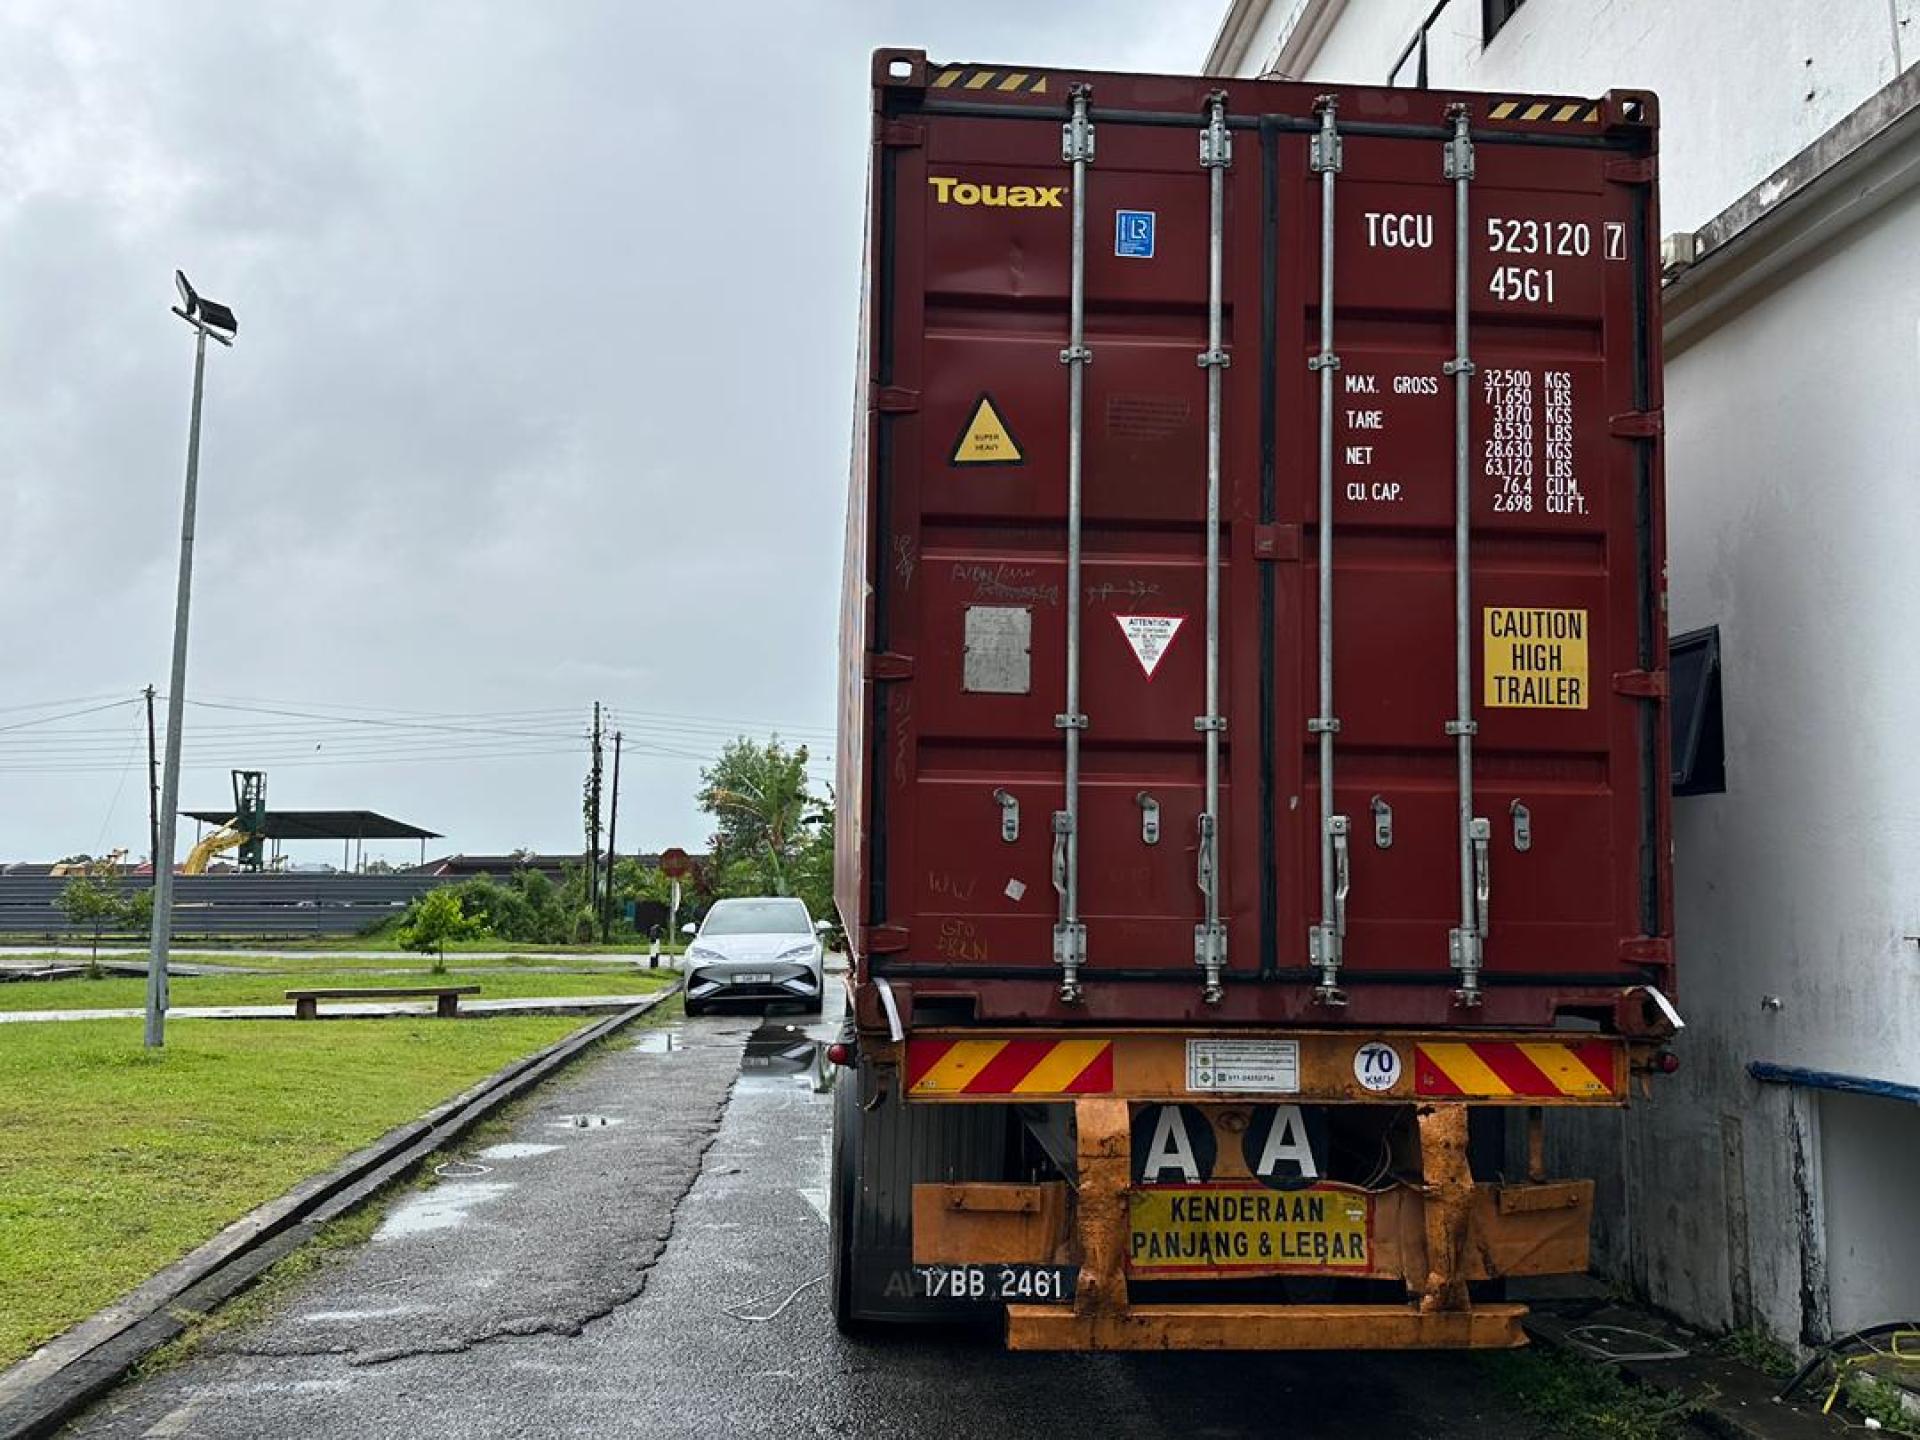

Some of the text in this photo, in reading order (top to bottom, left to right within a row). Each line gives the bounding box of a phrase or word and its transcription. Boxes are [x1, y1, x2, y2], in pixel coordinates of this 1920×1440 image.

[928, 177, 1064, 207] Touax
[1365, 213, 1623, 257] TGCU 523120 7
[1489, 267, 1555, 303] 45G1
[1346, 370, 1571, 395] MAX. GROSS 32.500 KGS
[1485, 388, 1572, 406] 71.650 LBS
[1346, 406, 1572, 429] TARE 3.870 KGS
[1494, 424, 1572, 441] 8.530 LBS
[1347, 441, 1573, 465] NET 28.630 KGS
[1485, 459, 1572, 477] 63.120 LBS
[1372, 483, 1404, 501] CAP.
[1502, 477, 1532, 494] 76.4
[1494, 495, 1533, 513] 2.698
[1129, 618, 1170, 626] ATTENTION
[1491, 610, 1582, 639] CAUTION
[1512, 643, 1562, 671] HIGH
[1494, 676, 1580, 705] TRAILER
[1360, 1049, 1393, 1073] 70
[1143, 1105, 1318, 1184] A A
[1171, 1196, 1324, 1223] KENDERAAN
[1132, 1231, 1364, 1260] PANJANG & LEBAR
[1001, 1270, 1061, 1297] 2461
